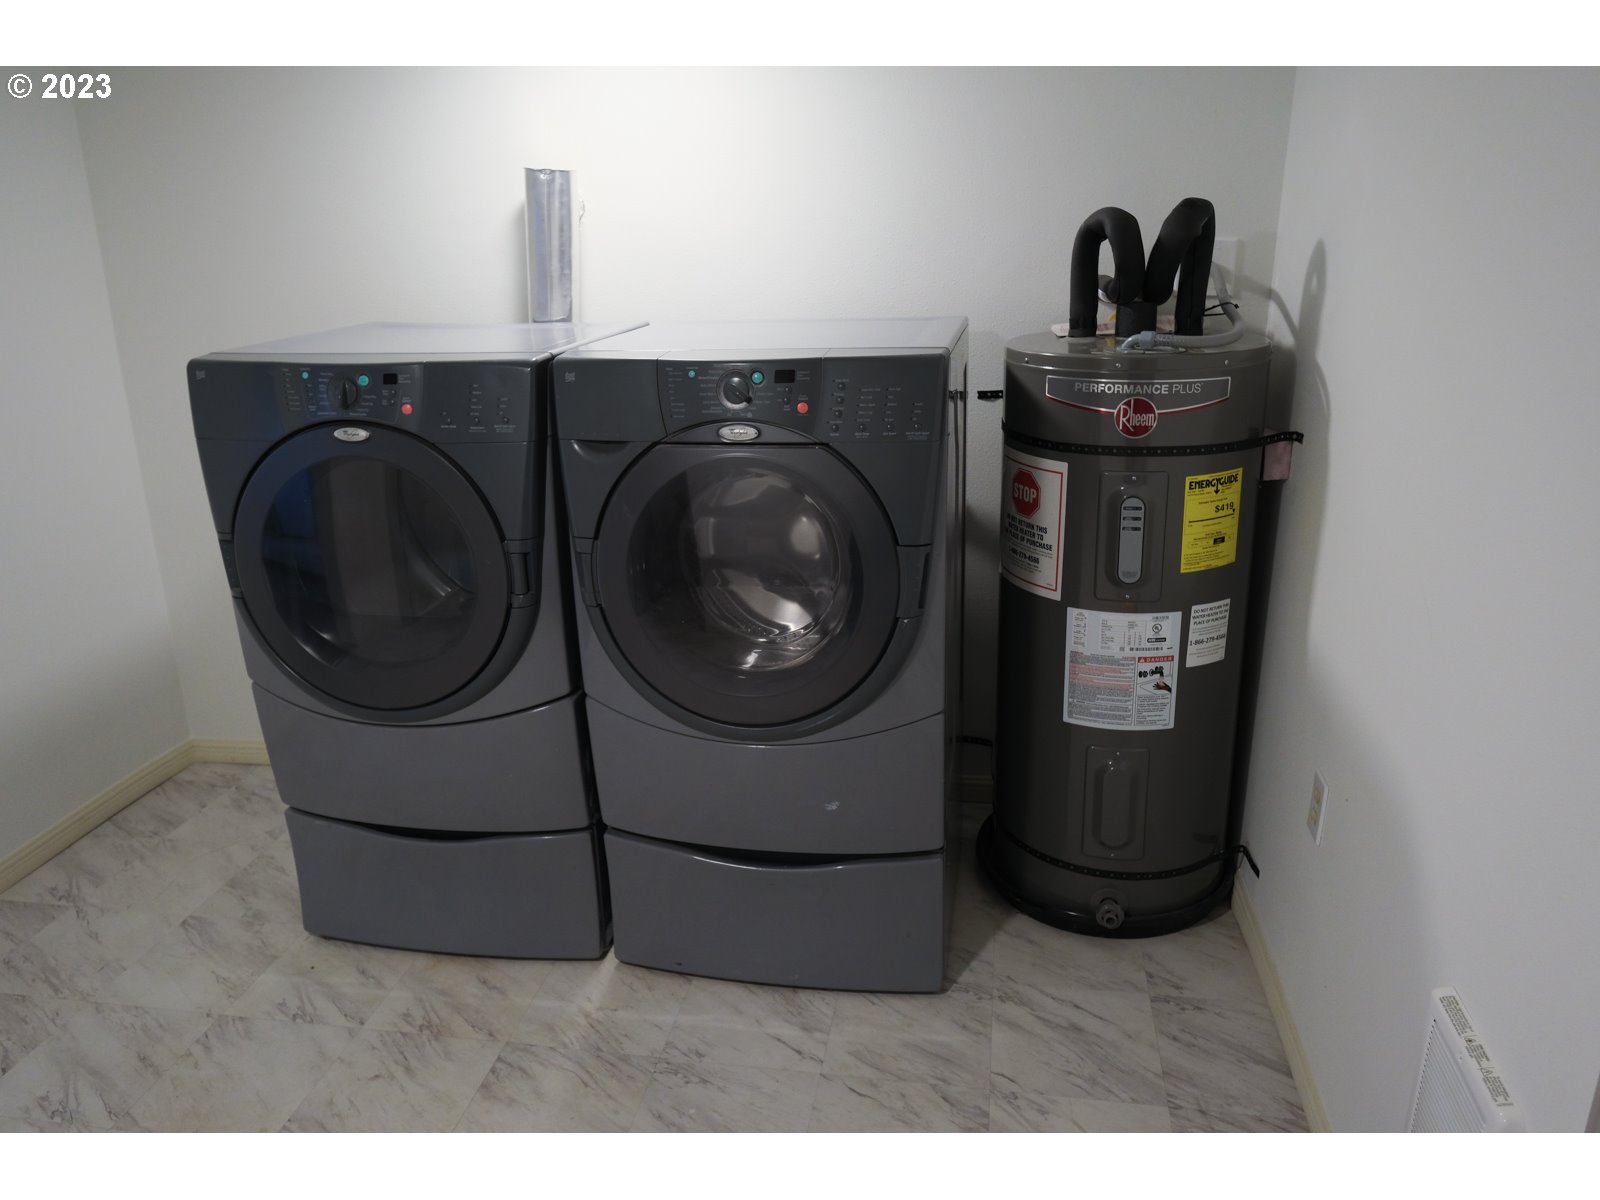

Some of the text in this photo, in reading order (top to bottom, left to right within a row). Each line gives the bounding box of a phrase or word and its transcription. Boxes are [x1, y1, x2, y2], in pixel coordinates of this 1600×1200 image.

[1074, 380, 1201, 395] PERFORMANCE PLUS
[1119, 399, 1155, 432] Rheem
[1188, 472, 1239, 491] ENERGYGUIDE
[1014, 482, 1037, 504] STOP
[1215, 501, 1234, 513] $419
[1036, 525, 1047, 534] THIS
[1026, 538, 1052, 551] PURCHASE
